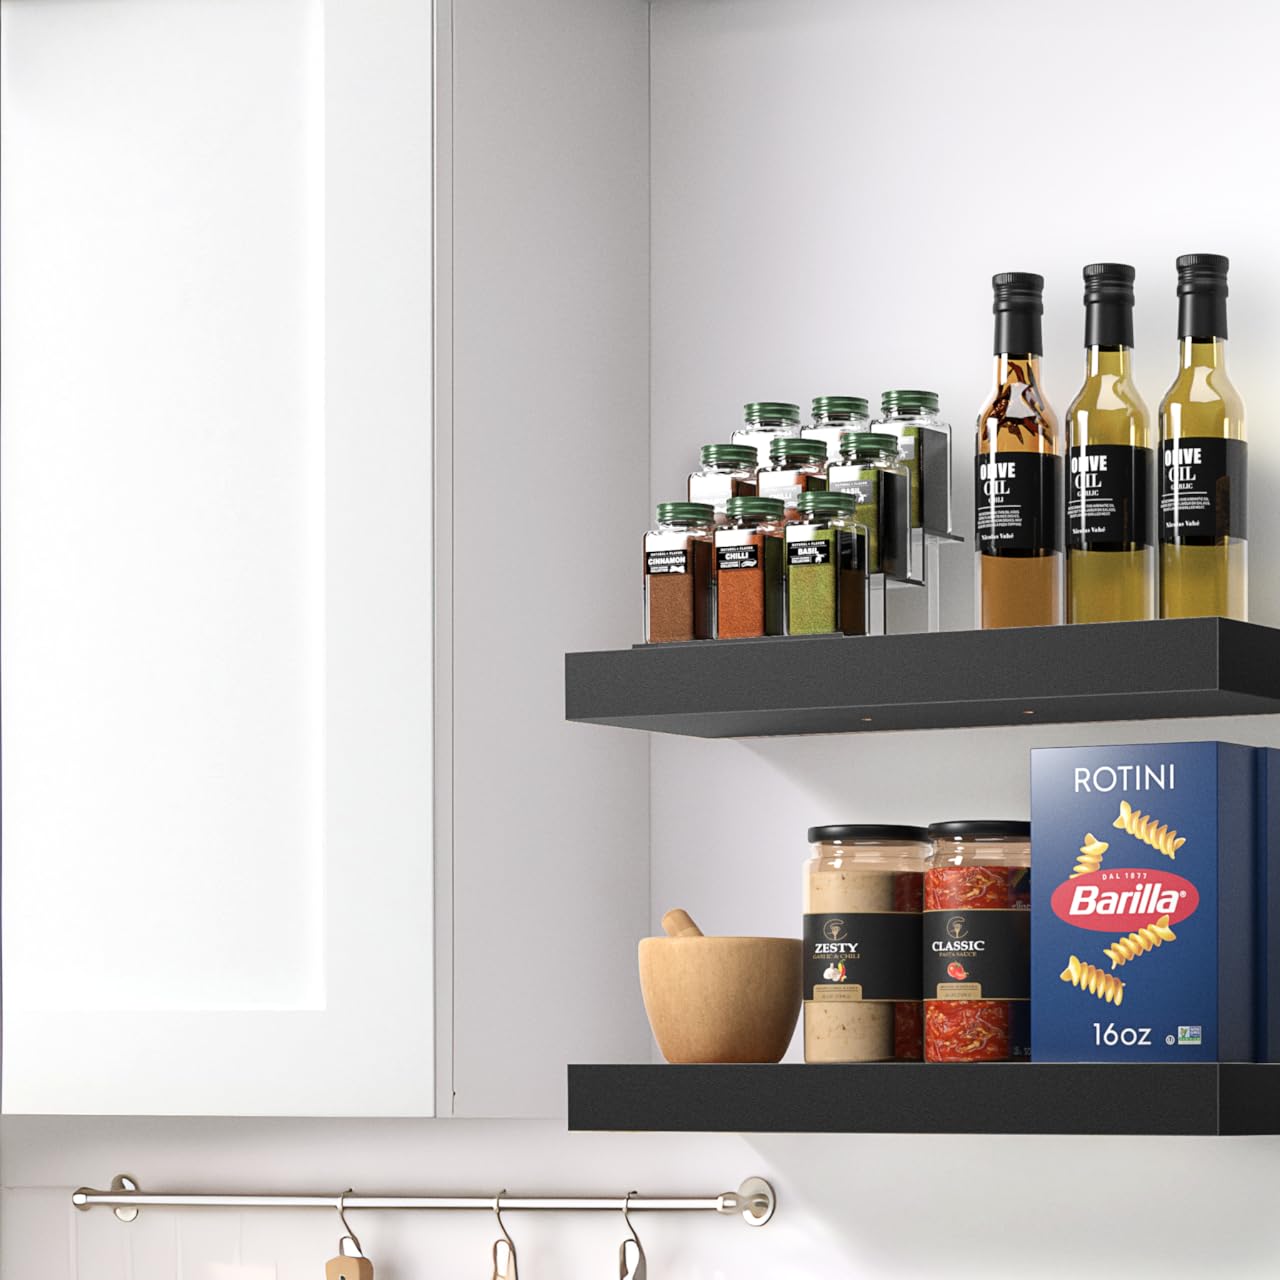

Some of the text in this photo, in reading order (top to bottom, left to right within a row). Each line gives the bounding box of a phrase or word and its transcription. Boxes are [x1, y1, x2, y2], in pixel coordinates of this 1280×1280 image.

[1073, 764, 1176, 793] ROTINI
[1125, 872, 1149, 880] 1877
[814, 942, 859, 954] ZESTY
[931, 940, 986, 952] CLASSIC
[1093, 1022, 1152, 1046] 16oz
